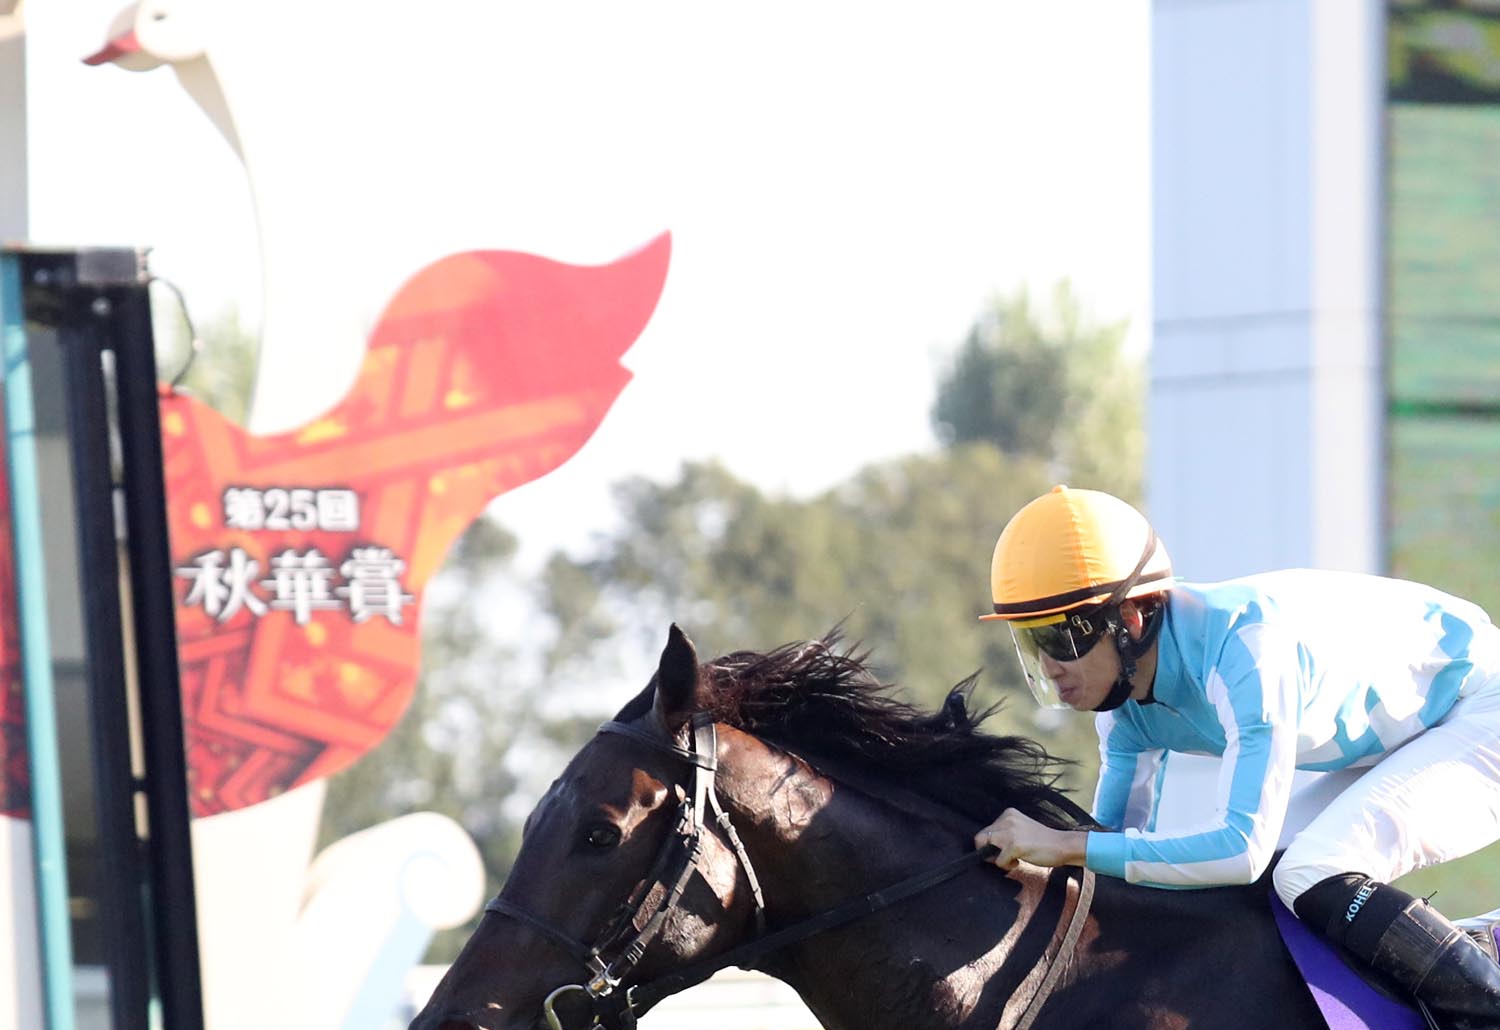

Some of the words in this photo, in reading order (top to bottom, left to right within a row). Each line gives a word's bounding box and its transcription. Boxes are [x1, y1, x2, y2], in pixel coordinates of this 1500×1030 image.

[224, 487, 359, 531] 第25回
[176, 547, 414, 624] 秋華賞
[1345, 885, 1373, 922] KOHEI
